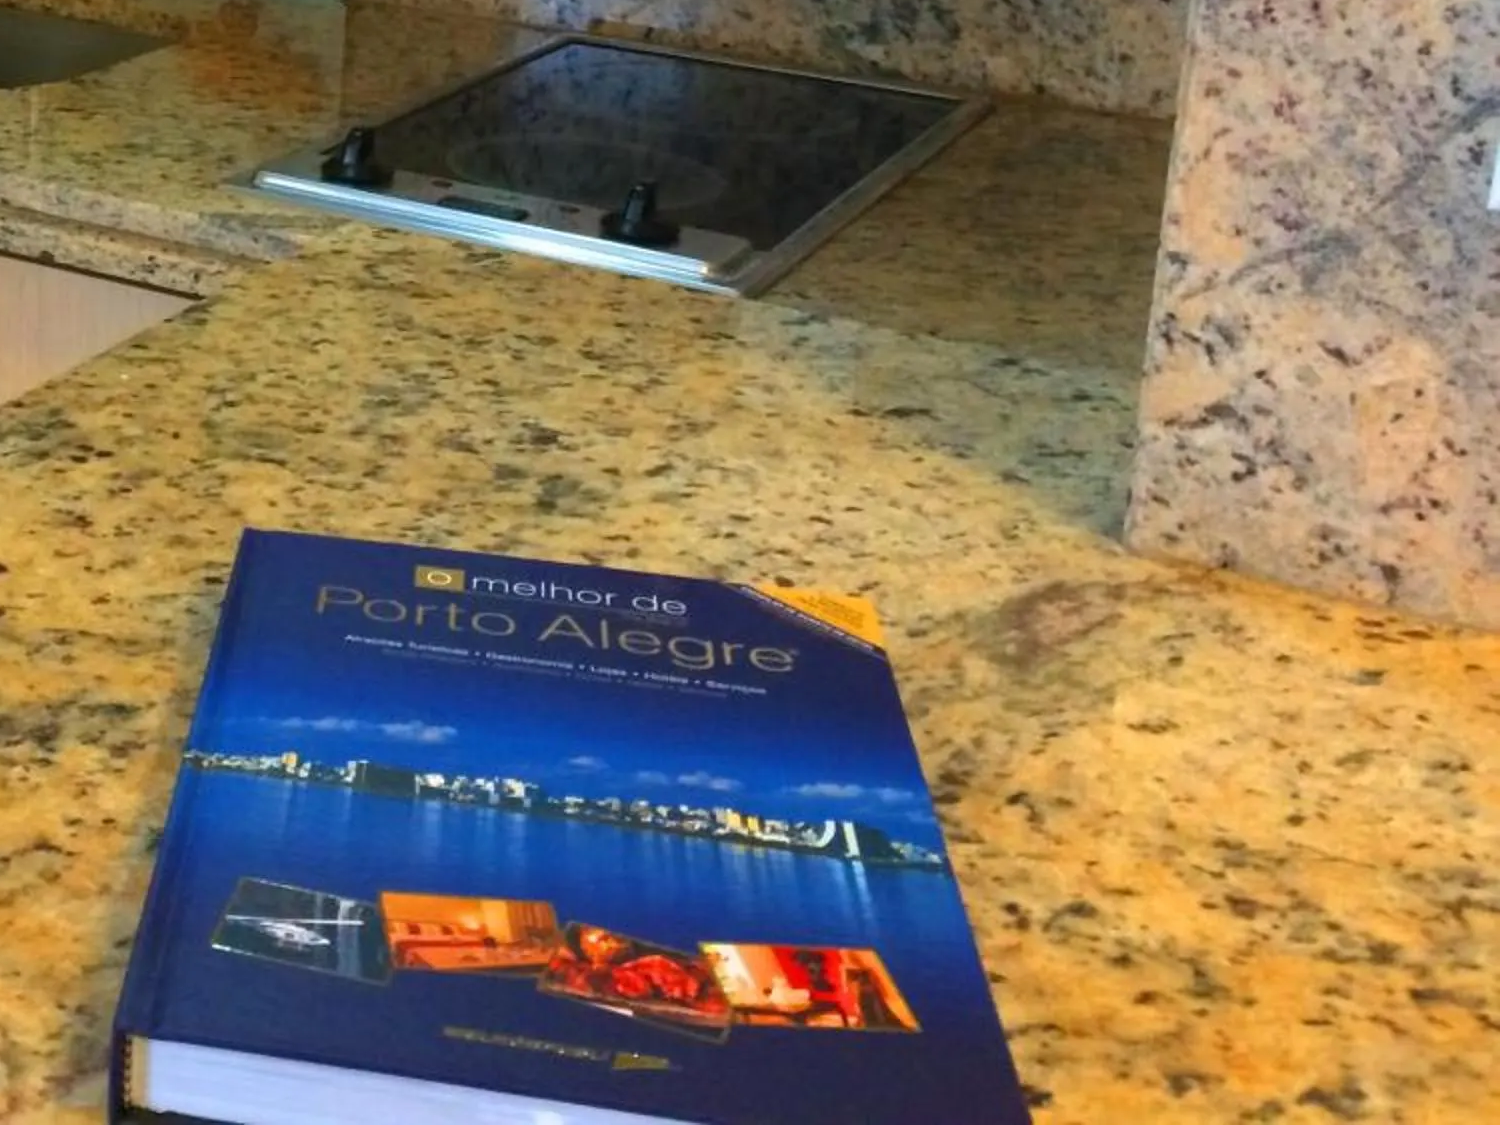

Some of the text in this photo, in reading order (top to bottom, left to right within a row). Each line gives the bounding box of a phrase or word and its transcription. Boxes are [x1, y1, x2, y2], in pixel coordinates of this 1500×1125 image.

[472, 575, 619, 607] melhor
[631, 594, 688, 616] de
[316, 584, 517, 637] Porto
[537, 614, 794, 672] Alegre
